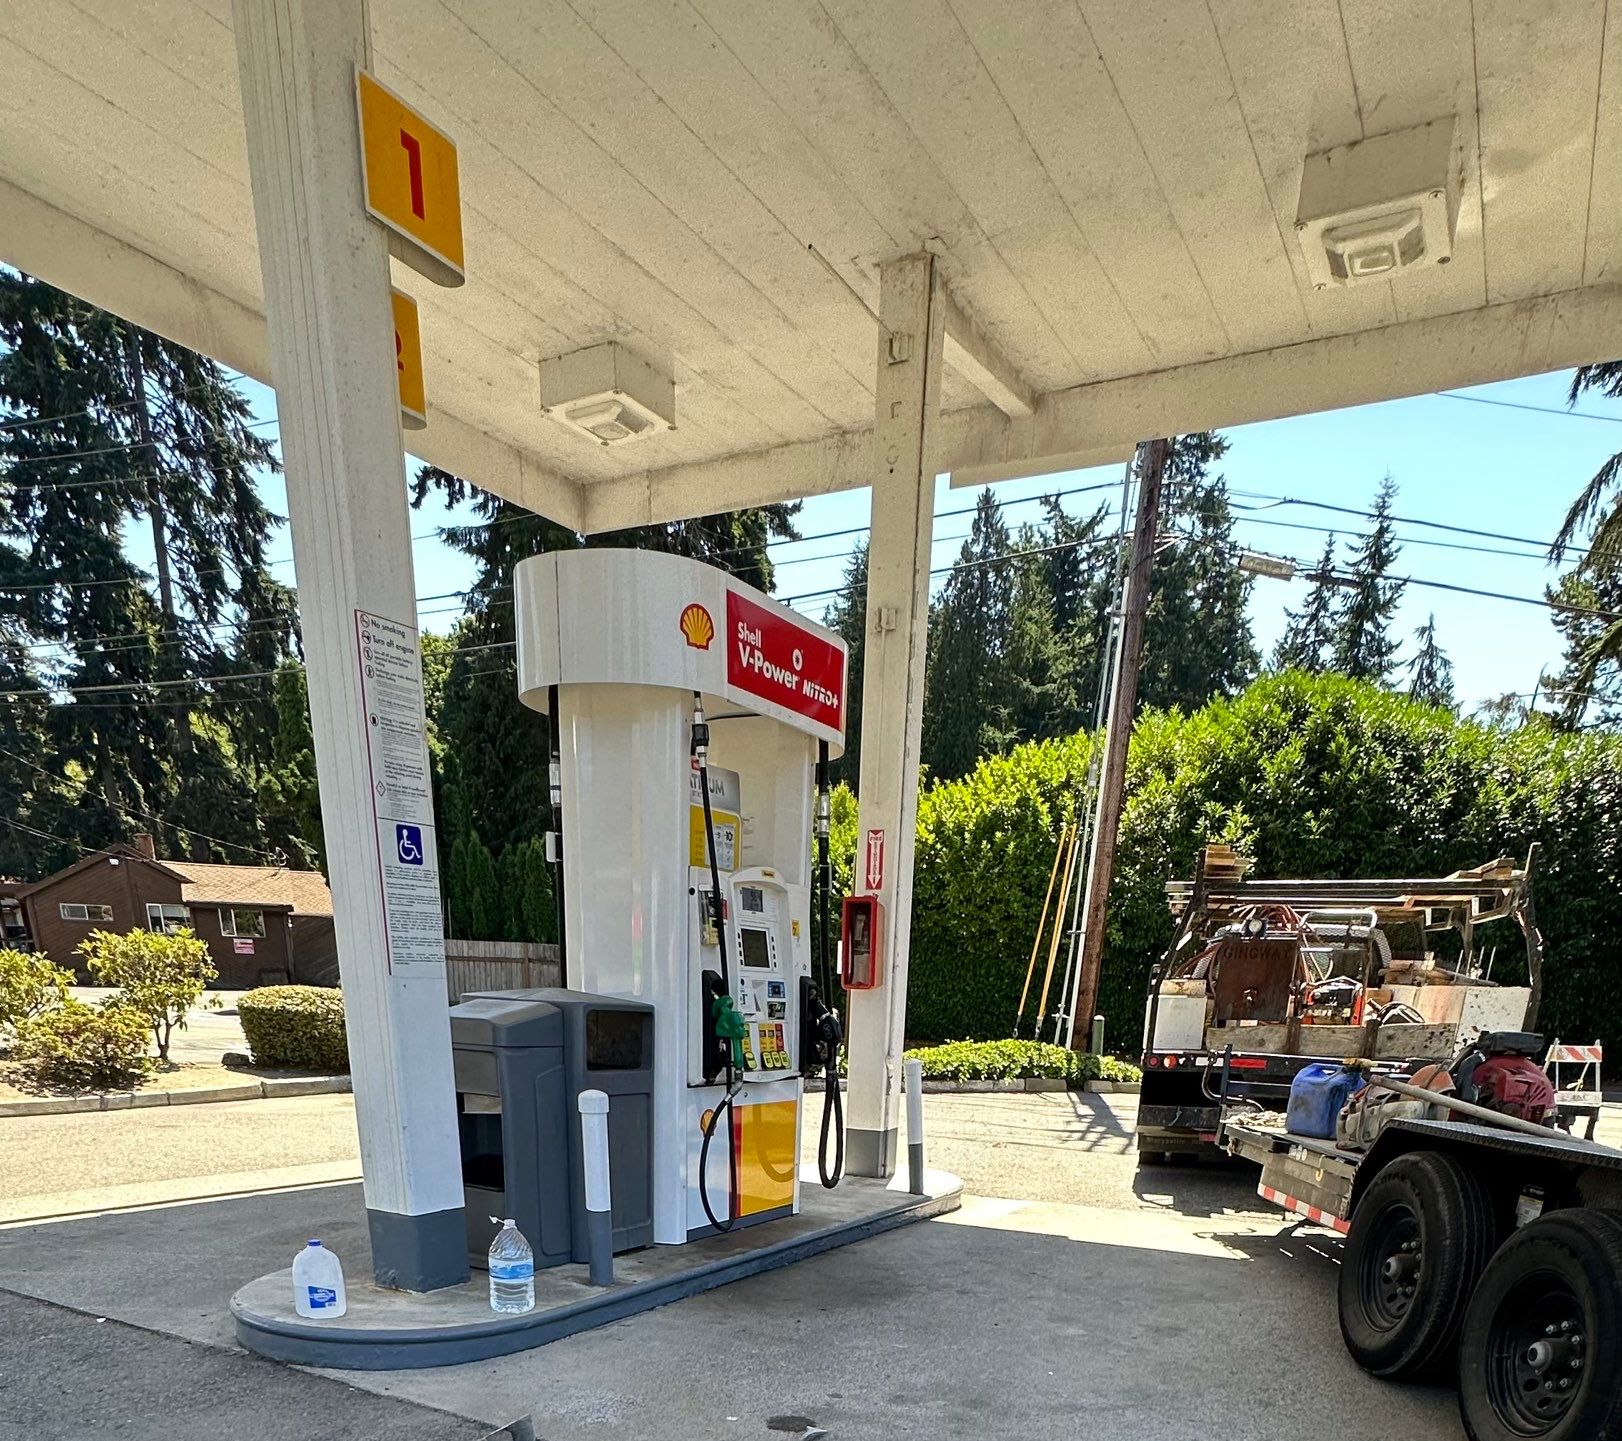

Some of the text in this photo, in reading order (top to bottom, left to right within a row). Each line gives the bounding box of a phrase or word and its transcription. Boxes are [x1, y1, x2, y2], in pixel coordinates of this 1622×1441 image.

[400, 127, 425, 221] 1
[738, 621, 762, 649] Shell
[738, 641, 799, 690] V-Power
